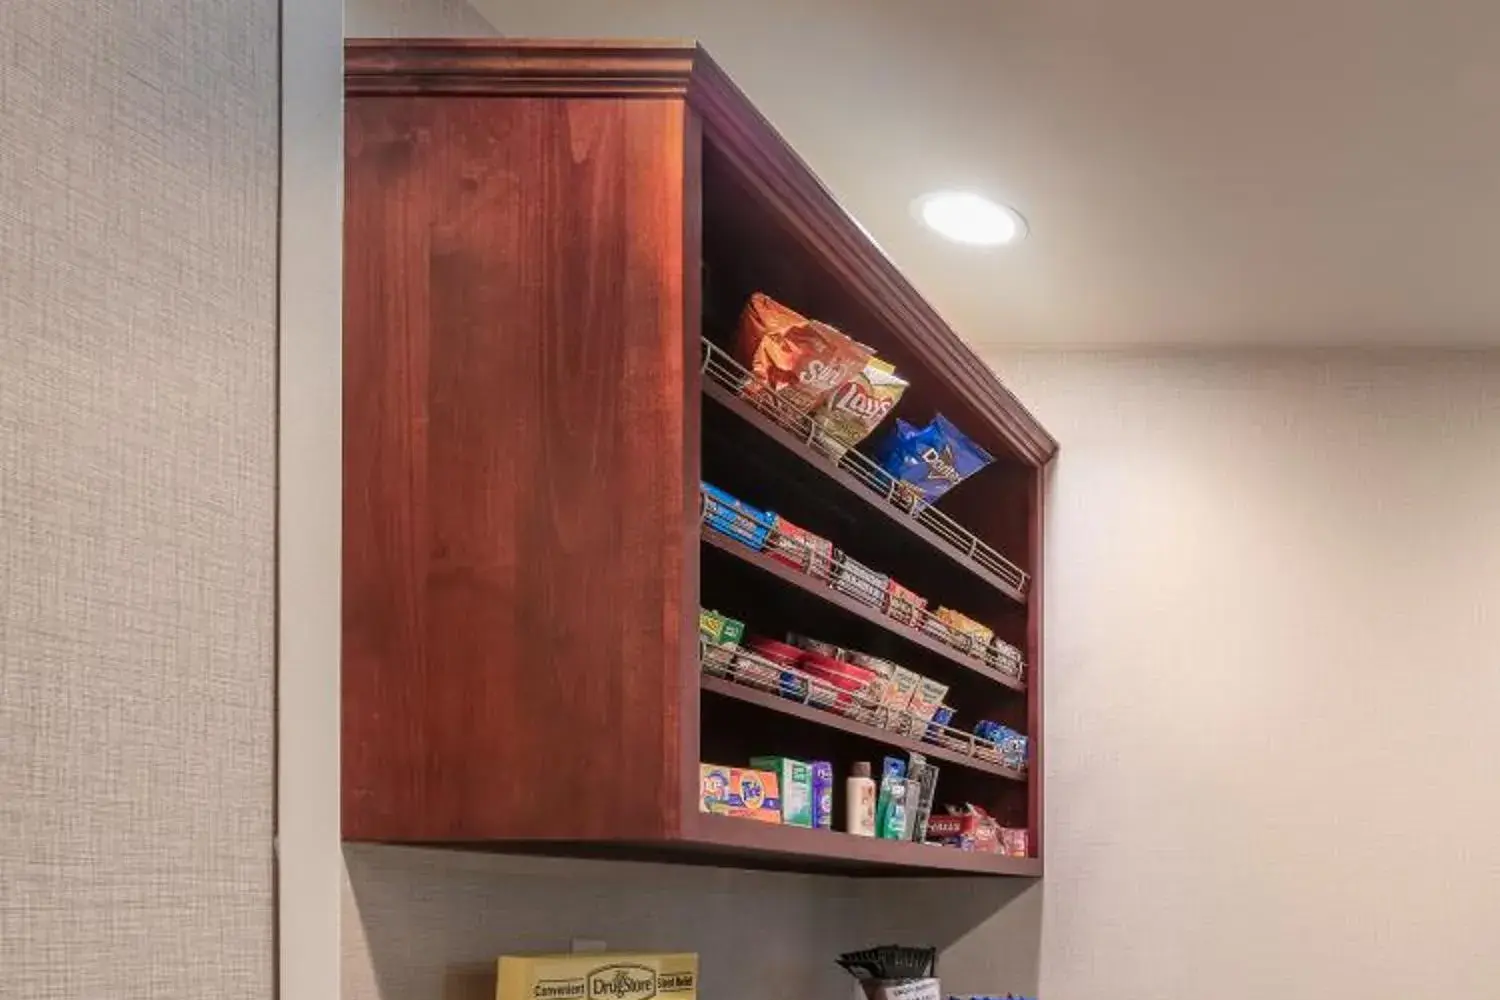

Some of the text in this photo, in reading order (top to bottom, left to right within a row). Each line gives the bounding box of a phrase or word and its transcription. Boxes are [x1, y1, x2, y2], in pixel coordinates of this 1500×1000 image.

[836, 382, 892, 424] Lay's
[535, 982, 585, 997] Convenient
[593, 976, 651, 998] DrugStore
